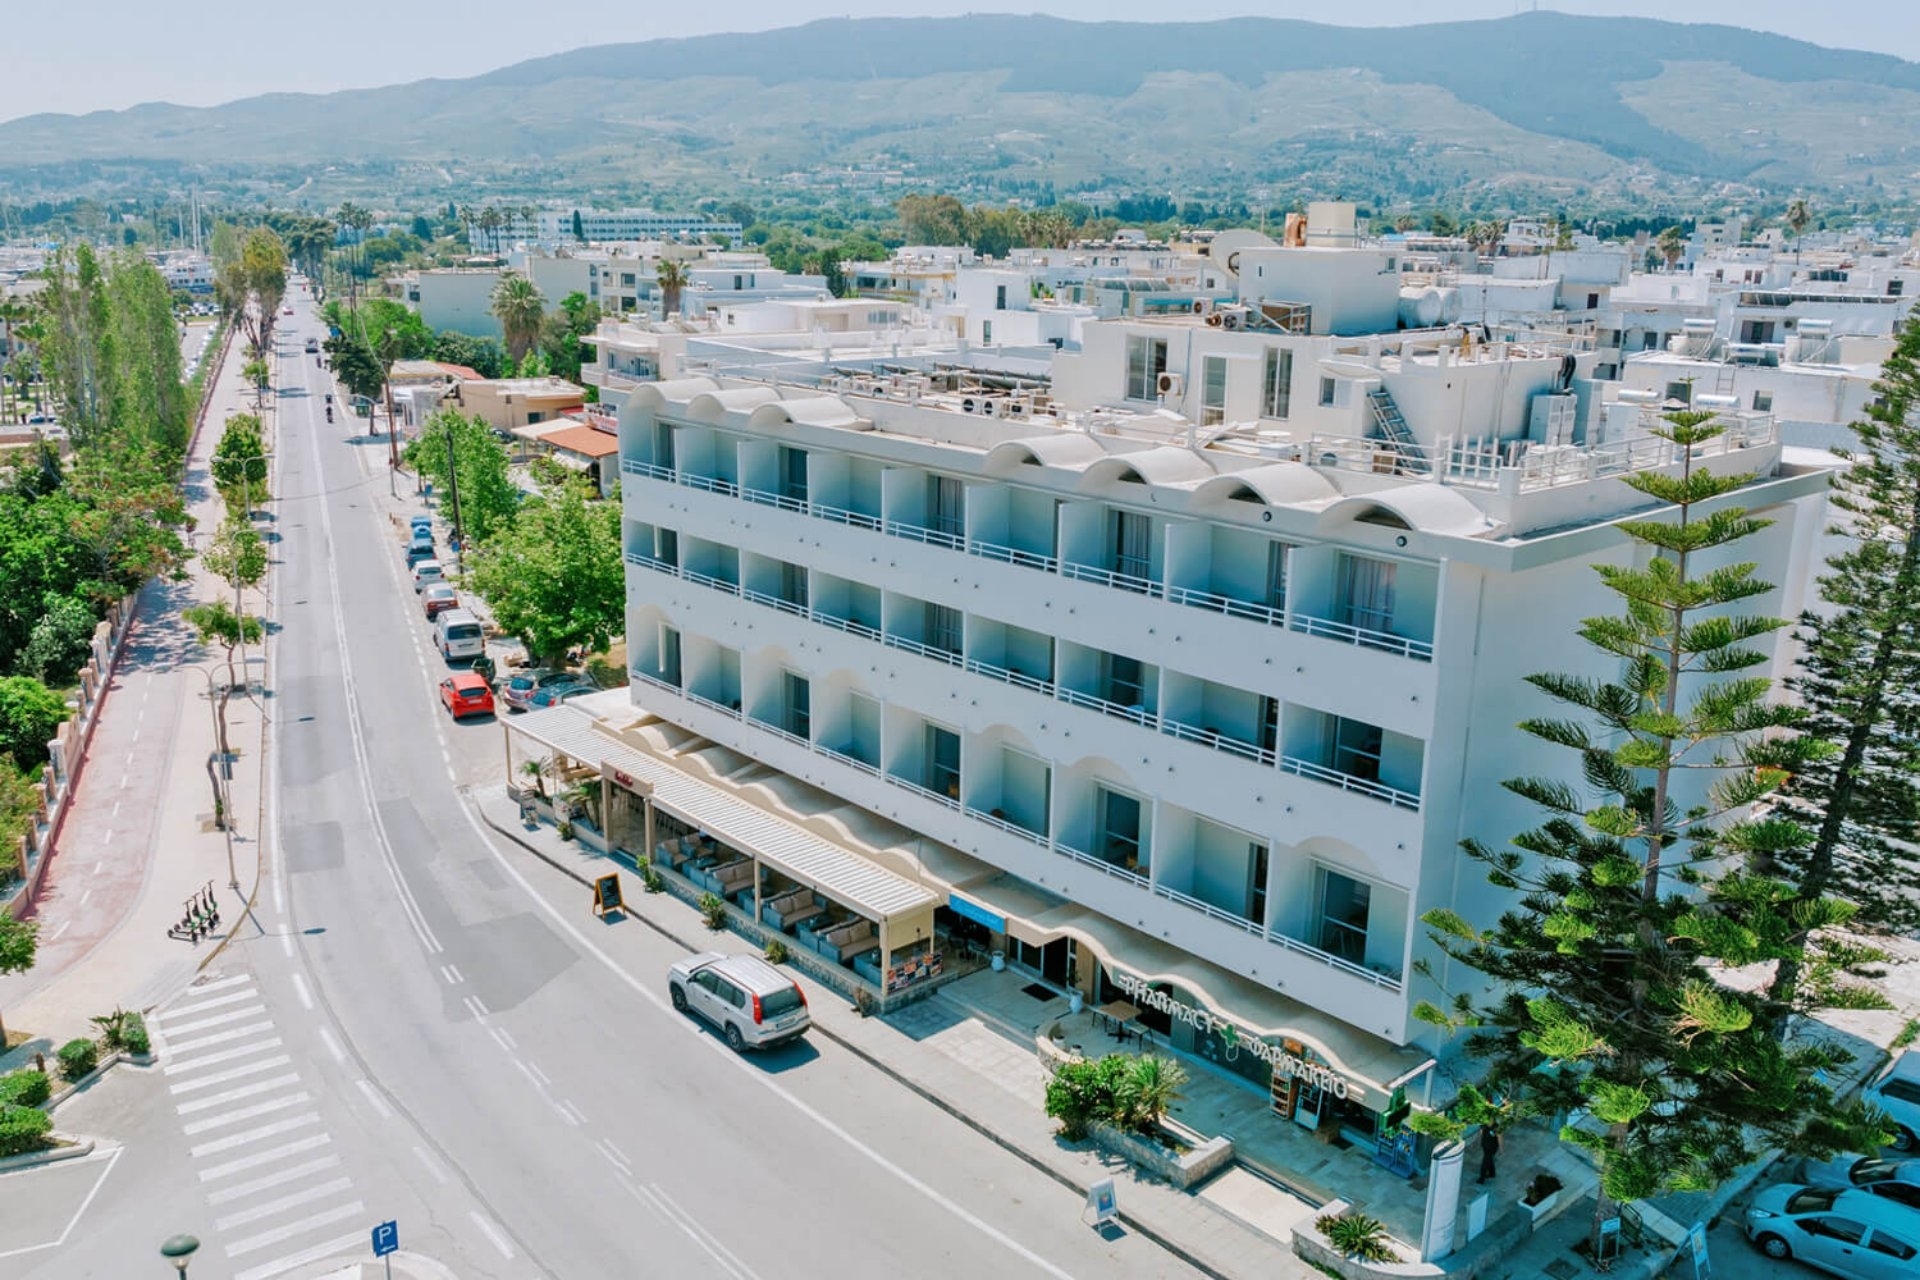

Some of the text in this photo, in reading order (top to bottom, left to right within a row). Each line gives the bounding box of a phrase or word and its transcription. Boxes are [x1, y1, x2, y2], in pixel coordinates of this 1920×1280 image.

[1125, 976, 1214, 1034] PHARMACY
[1250, 1038, 1349, 1099] ΦΑΡΜΑΚΕΙΟ
[379, 1226, 392, 1244] P
